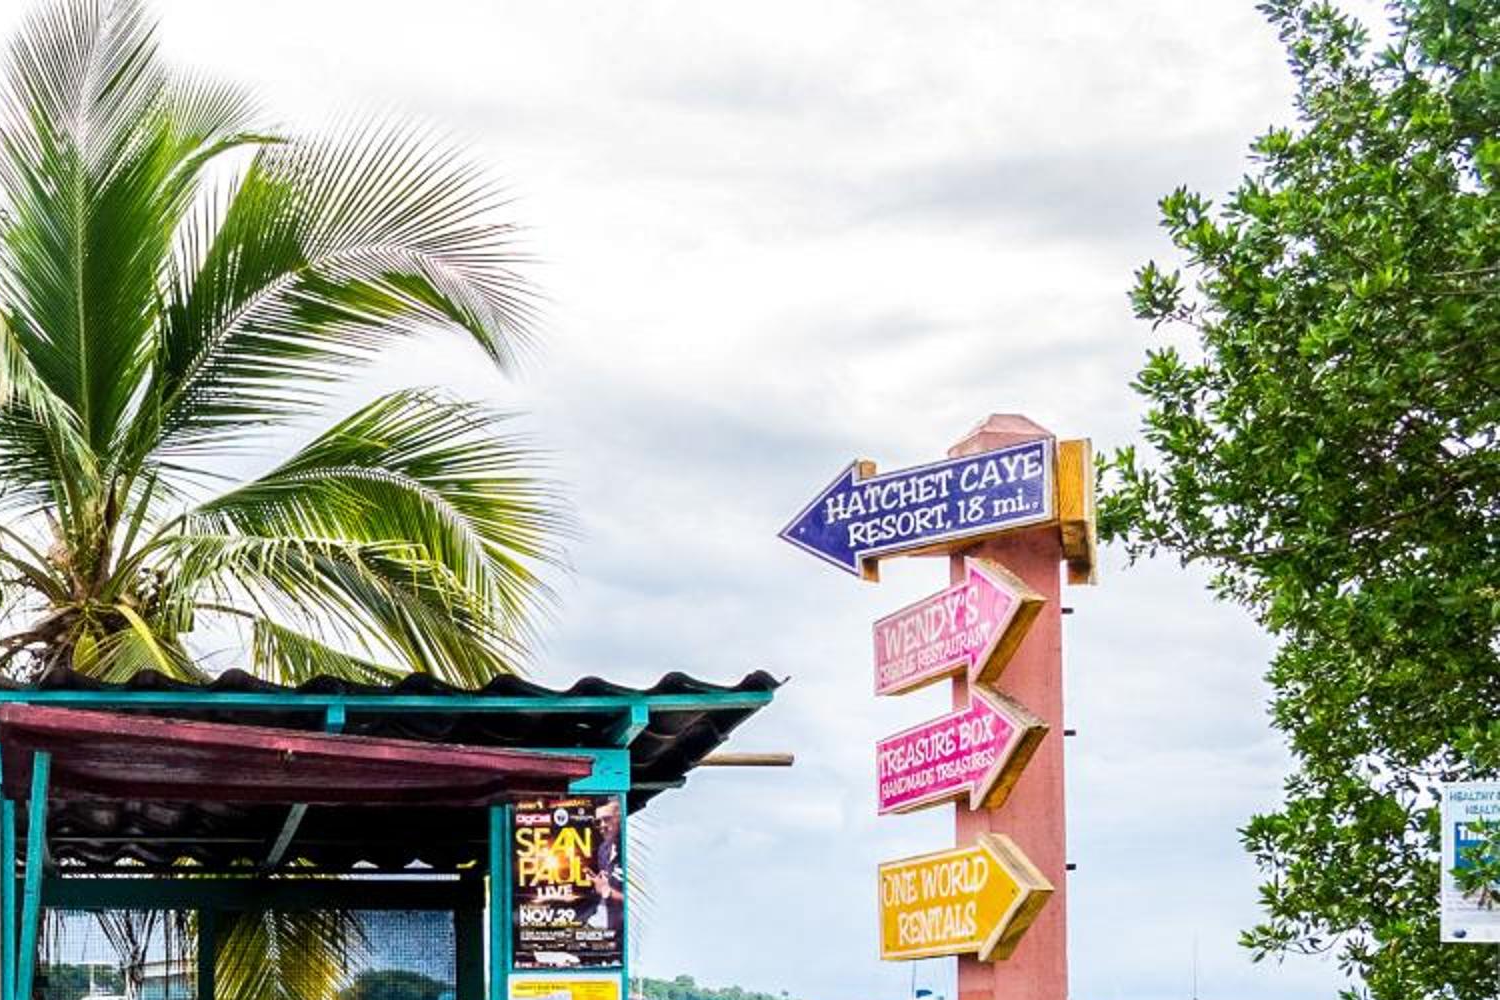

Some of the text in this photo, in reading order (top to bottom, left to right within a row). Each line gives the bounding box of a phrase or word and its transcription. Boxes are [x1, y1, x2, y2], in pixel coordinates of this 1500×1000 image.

[825, 450, 1043, 524] HATCHET CAYE
[848, 503, 951, 548] RESORT,
[958, 495, 984, 524] 18
[884, 586, 980, 660] WENDY'S
[918, 621, 991, 671] RESTAURANT
[880, 713, 995, 777] TREASURE BOX
[881, 767, 934, 798] HANDMADE
[515, 827, 592, 858] SEAN
[519, 854, 592, 887] PAUL
[536, 885, 573, 899] LIVE
[884, 856, 989, 907] ONE WORLD
[897, 901, 977, 946] RENTALS
